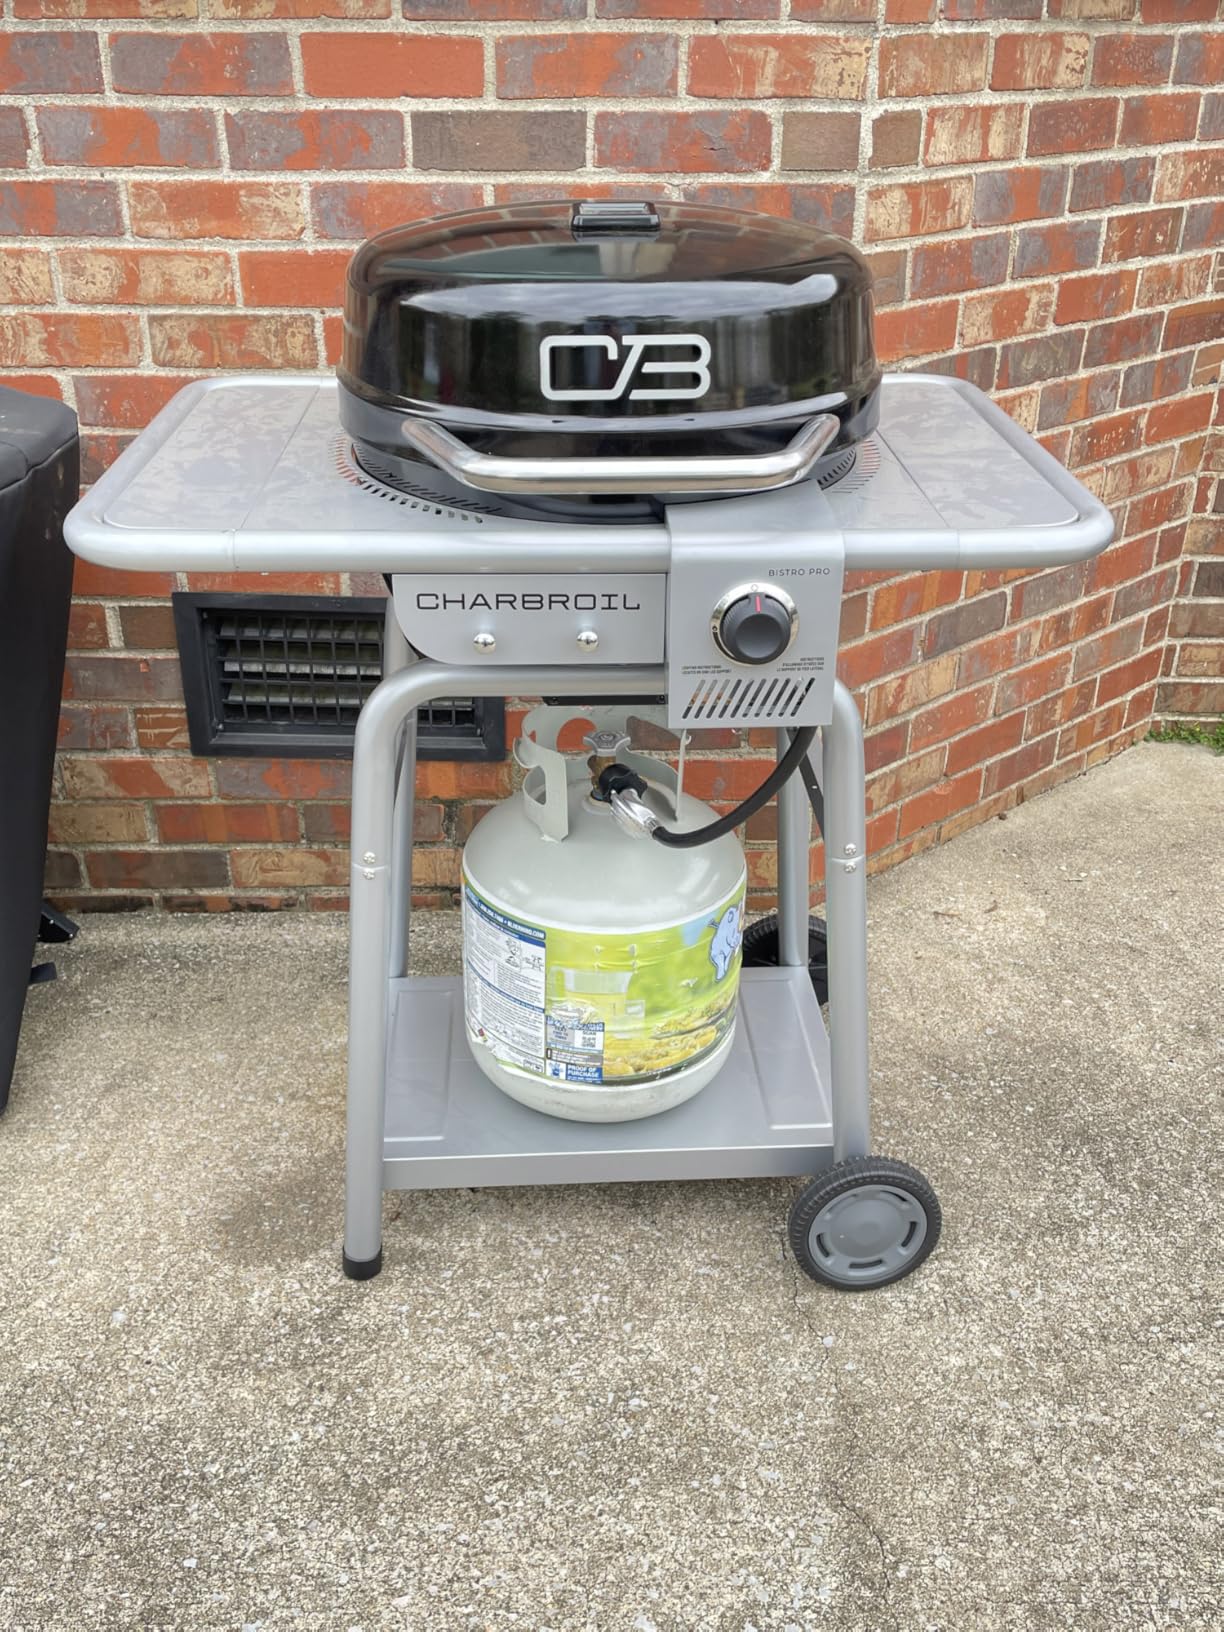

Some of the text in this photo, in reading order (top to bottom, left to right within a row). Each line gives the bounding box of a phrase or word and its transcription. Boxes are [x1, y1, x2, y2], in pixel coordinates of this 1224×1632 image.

[540, 334, 711, 400] CB
[768, 567, 831, 577] BISTRO PRO
[416, 593, 641, 610] CHARBROIL
[567, 1069, 600, 1078] PURCHASE
